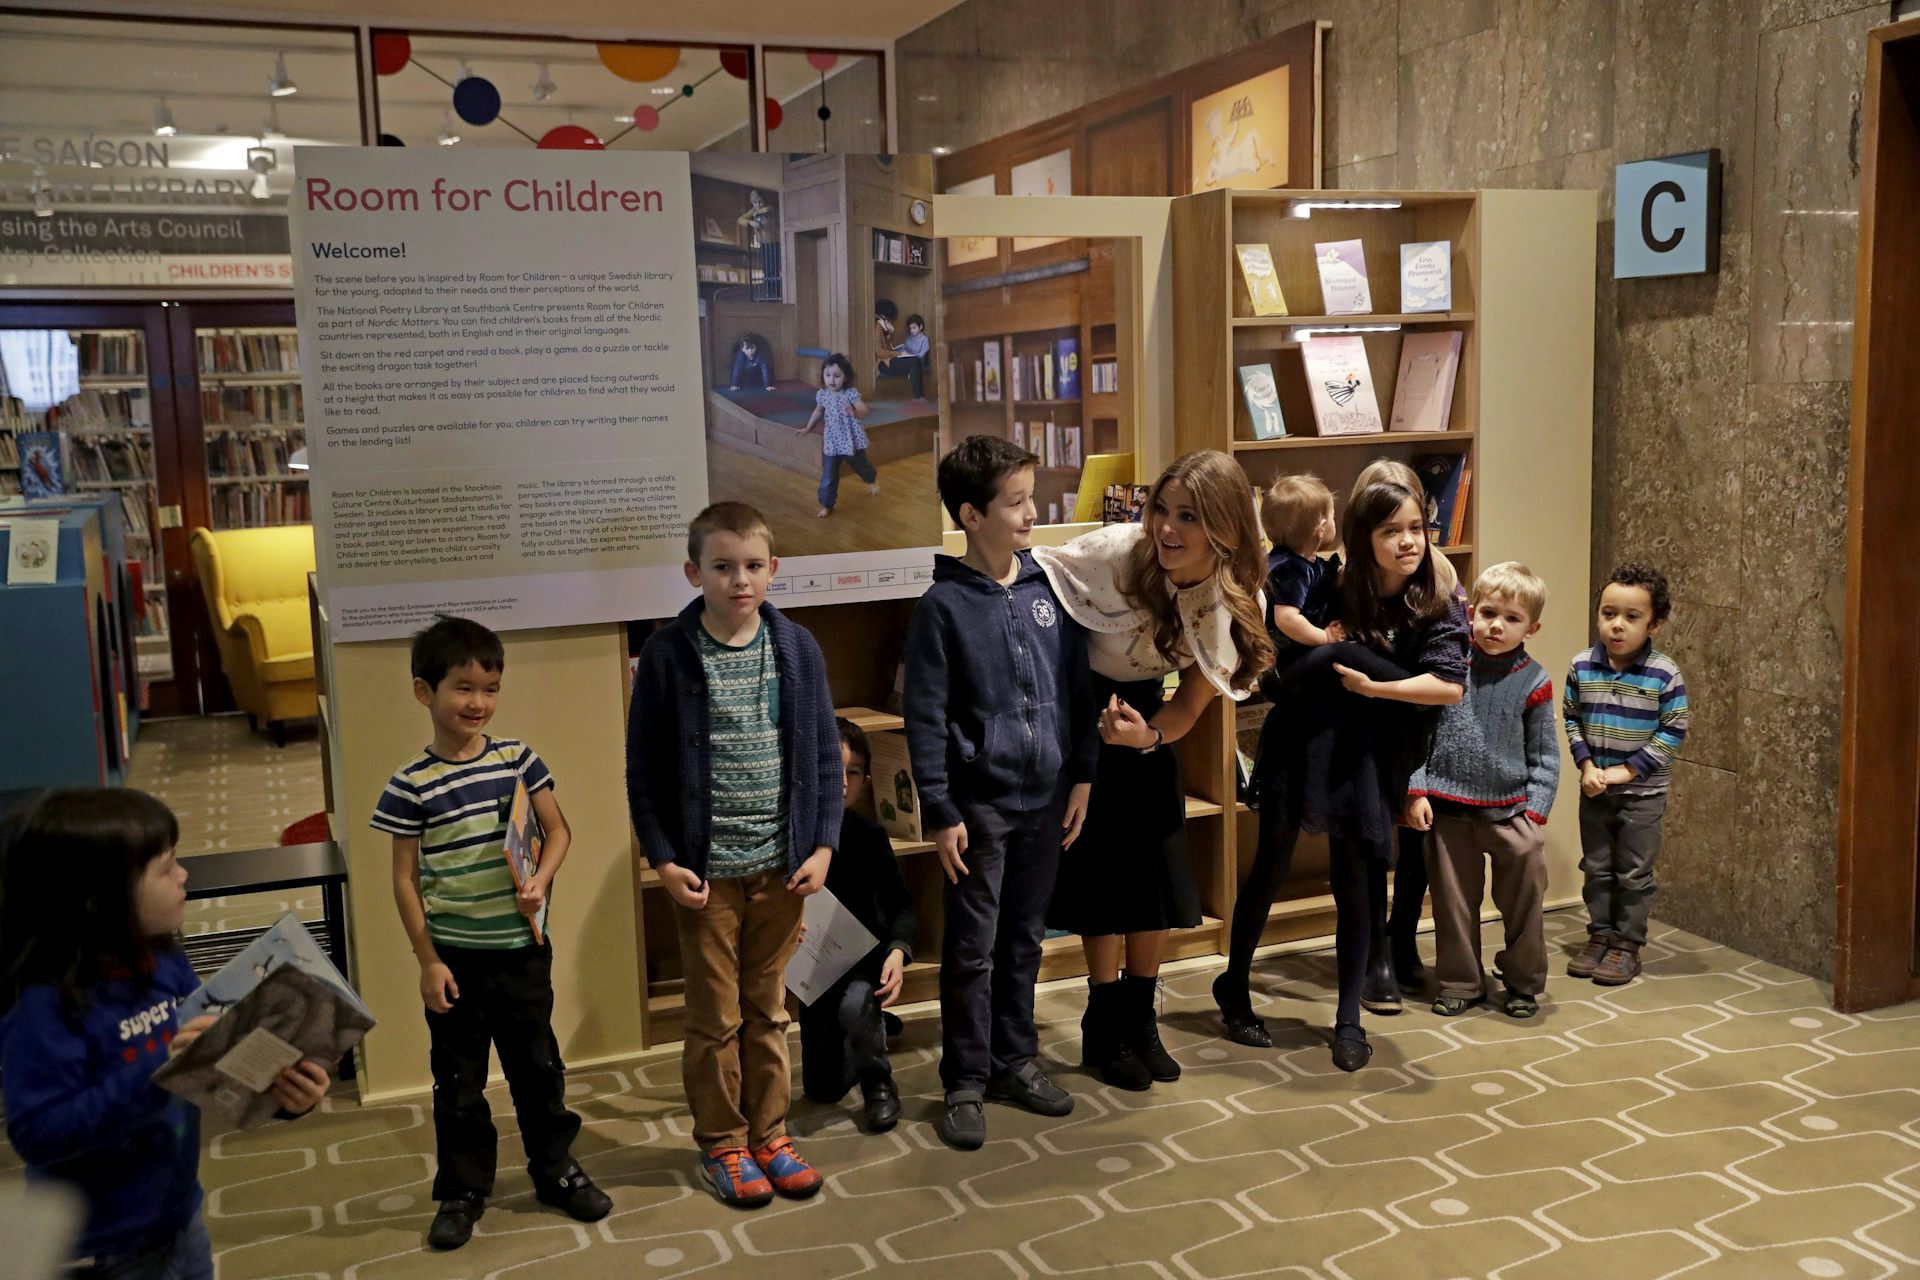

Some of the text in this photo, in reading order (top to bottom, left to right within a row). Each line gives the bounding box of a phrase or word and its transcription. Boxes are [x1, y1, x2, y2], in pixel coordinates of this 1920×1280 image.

[33, 138, 169, 168] SAISON
[306, 178, 663, 212] Room for Children
[1641, 181, 1686, 253] C
[58, 218, 97, 237] the
[103, 218, 152, 238] Arts
[158, 218, 244, 239] Council
[44, 244, 162, 264] Collection
[311, 242, 407, 259] Welcome!
[168, 263, 275, 279] CHILDREN'S
[314, 274, 333, 283] The
[364, 273, 397, 282] before
[398, 275, 416, 285] you
[418, 273, 425, 282] is
[427, 273, 464, 285] inspired
[466, 273, 477, 284] by
[479, 272, 505, 281] Room
[506, 272, 520, 281] for
[522, 272, 560, 281] Children
[577, 271, 606, 283] unique
[608, 271, 642, 280] Swedish
[644, 271, 674, 283] library
[315, 287, 330, 296] for
[332, 287, 348, 296] the
[383, 286, 422, 298] adapted
[424, 285, 434, 294] to
[436, 285, 458, 294] their
[460, 285, 488, 294] needs
[490, 284, 507, 294] and
[509, 284, 530, 293] their
[533, 283, 585, 296] perceptions
[586, 283, 596, 292] of
[598, 283, 612, 292] the
[316, 300, 664, 317] The National Poetry Library at Southbank Centre presents Room for Children
[331, 318, 352, 330] part
[355, 318, 364, 327] of
[368, 317, 398, 327] Nordic
[442, 316, 458, 325] You
[480, 315, 497, 324] find
[499, 314, 540, 324] children's
[542, 314, 568, 323] books
[570, 313, 592, 322] from
[594, 313, 604, 322] all
[606, 313, 615, 322] of
[617, 313, 631, 322] the
[633, 312, 662, 321] Nordic
[318, 330, 364, 340] countries
[428, 329, 450, 338] both
[452, 328, 460, 337] in
[462, 328, 494, 340] English
[496, 327, 513, 336] and
[515, 327, 523, 336] in
[525, 326, 547, 336] their
[548, 326, 582, 338] original
[321, 359, 477, 374] the exciting dragon task together!
[322, 381, 335, 390] All
[337, 381, 352, 390] the
[354, 380, 382, 390] books
[404, 378, 448, 391] arranged
[450, 377, 462, 389] by
[464, 377, 486, 386] their
[488, 375, 520, 388] subject
[522, 375, 539, 384] and
[559, 373, 588, 386] placed
[590, 372, 617, 385] facing
[618, 371, 659, 381] outwards
[326, 424, 360, 434] Games
[361, 423, 380, 433] and
[382, 422, 416, 435] puzzles
[436, 420, 477, 430] available
[479, 419, 493, 428] for
[515, 417, 552, 427] children
[553, 418, 570, 426] can
[572, 416, 585, 428] try
[586, 414, 617, 427] writing
[618, 414, 639, 423] their
[342, 437, 357, 446] the
[359, 435, 393, 448] lending
[395, 434, 411, 444] list!
[331, 490, 354, 498] Room
[368, 488, 402, 496] Children
[411, 486, 440, 494] located
[464, 483, 502, 492] Stockholm
[519, 512, 547, 520] engage
[578, 507, 603, 517] library
[626, 504, 657, 512] Activities
[535, 519, 558, 527] based
[596, 515, 635, 523] Convention
[660, 512, 681, 521] Rights
[336, 550, 369, 558] Children
[400, 546, 429, 554] awaken
[468, 542, 501, 553] curiosity
[119, 1000, 170, 1040] super
